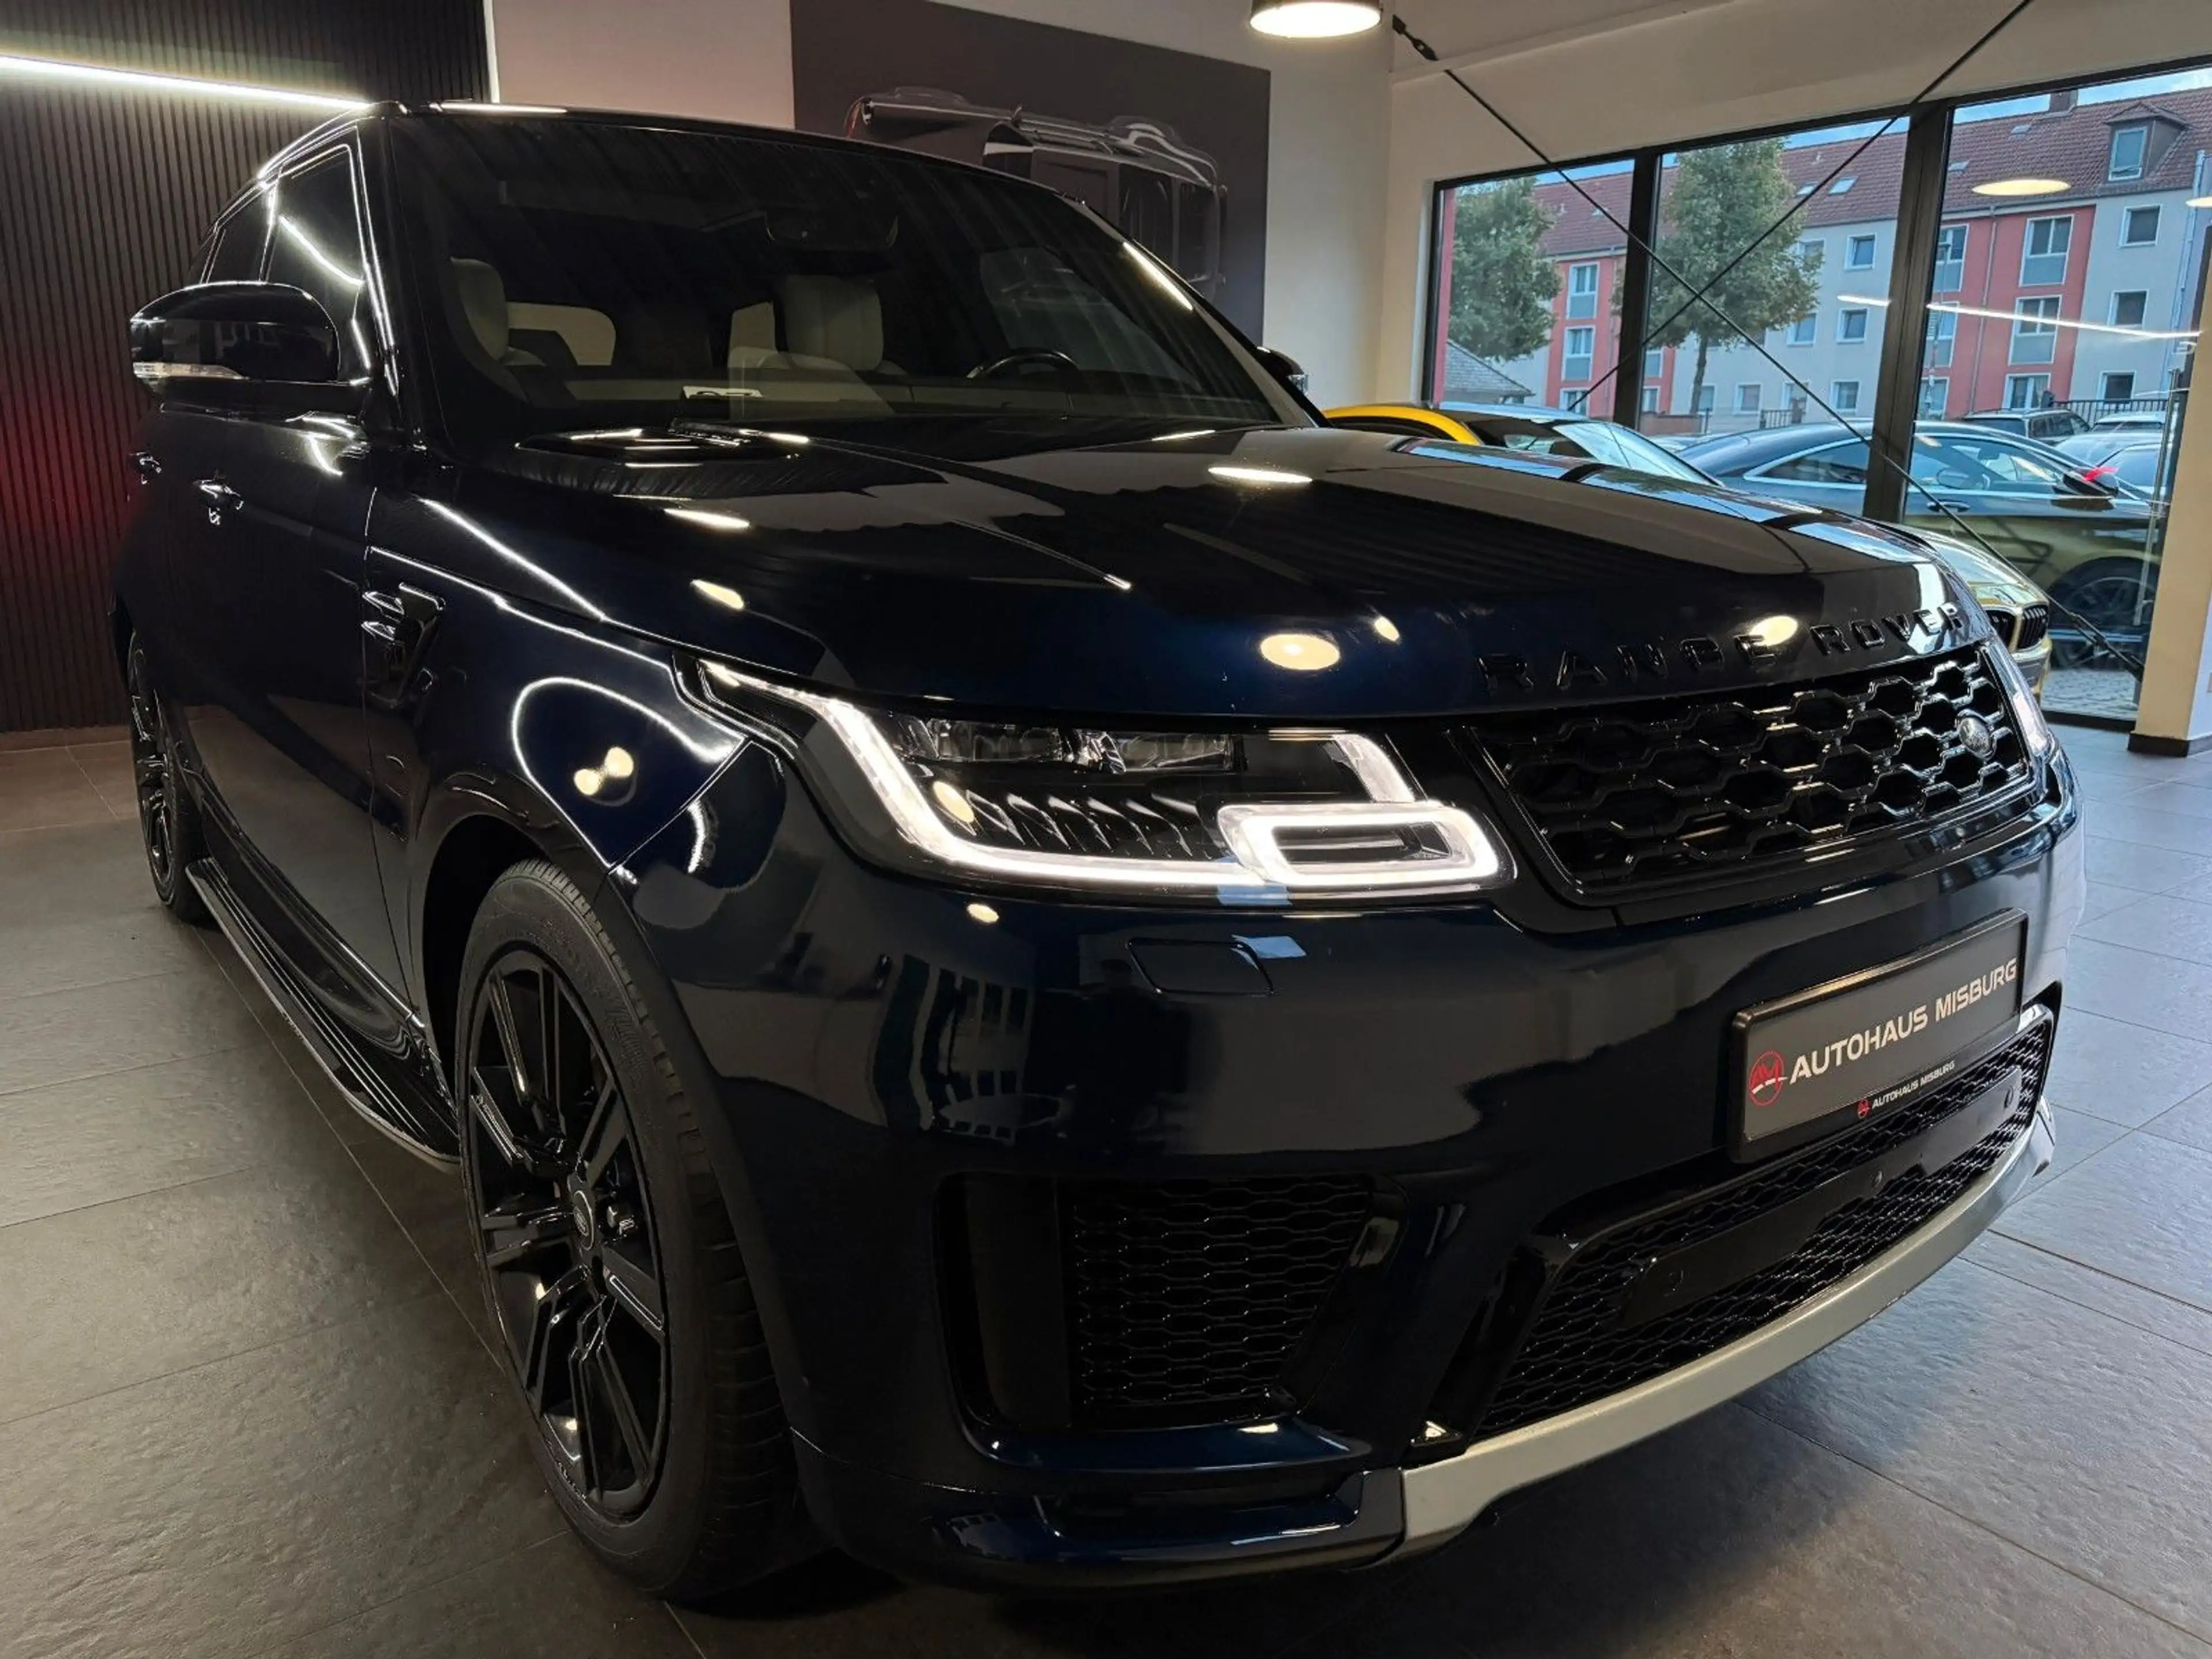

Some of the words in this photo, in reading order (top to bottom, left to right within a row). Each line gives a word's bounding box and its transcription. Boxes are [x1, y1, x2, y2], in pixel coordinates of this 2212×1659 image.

[1476, 632, 1777, 691] RANGE
[1809, 601, 1965, 656] ROVER
[1789, 1005, 1929, 1085] AUTOHAUS
[1935, 957, 2017, 1022] MISBURG
[1872, 1080, 1919, 1109] AUTOHAUS
[1919, 1059, 1955, 1087] MISBURG
